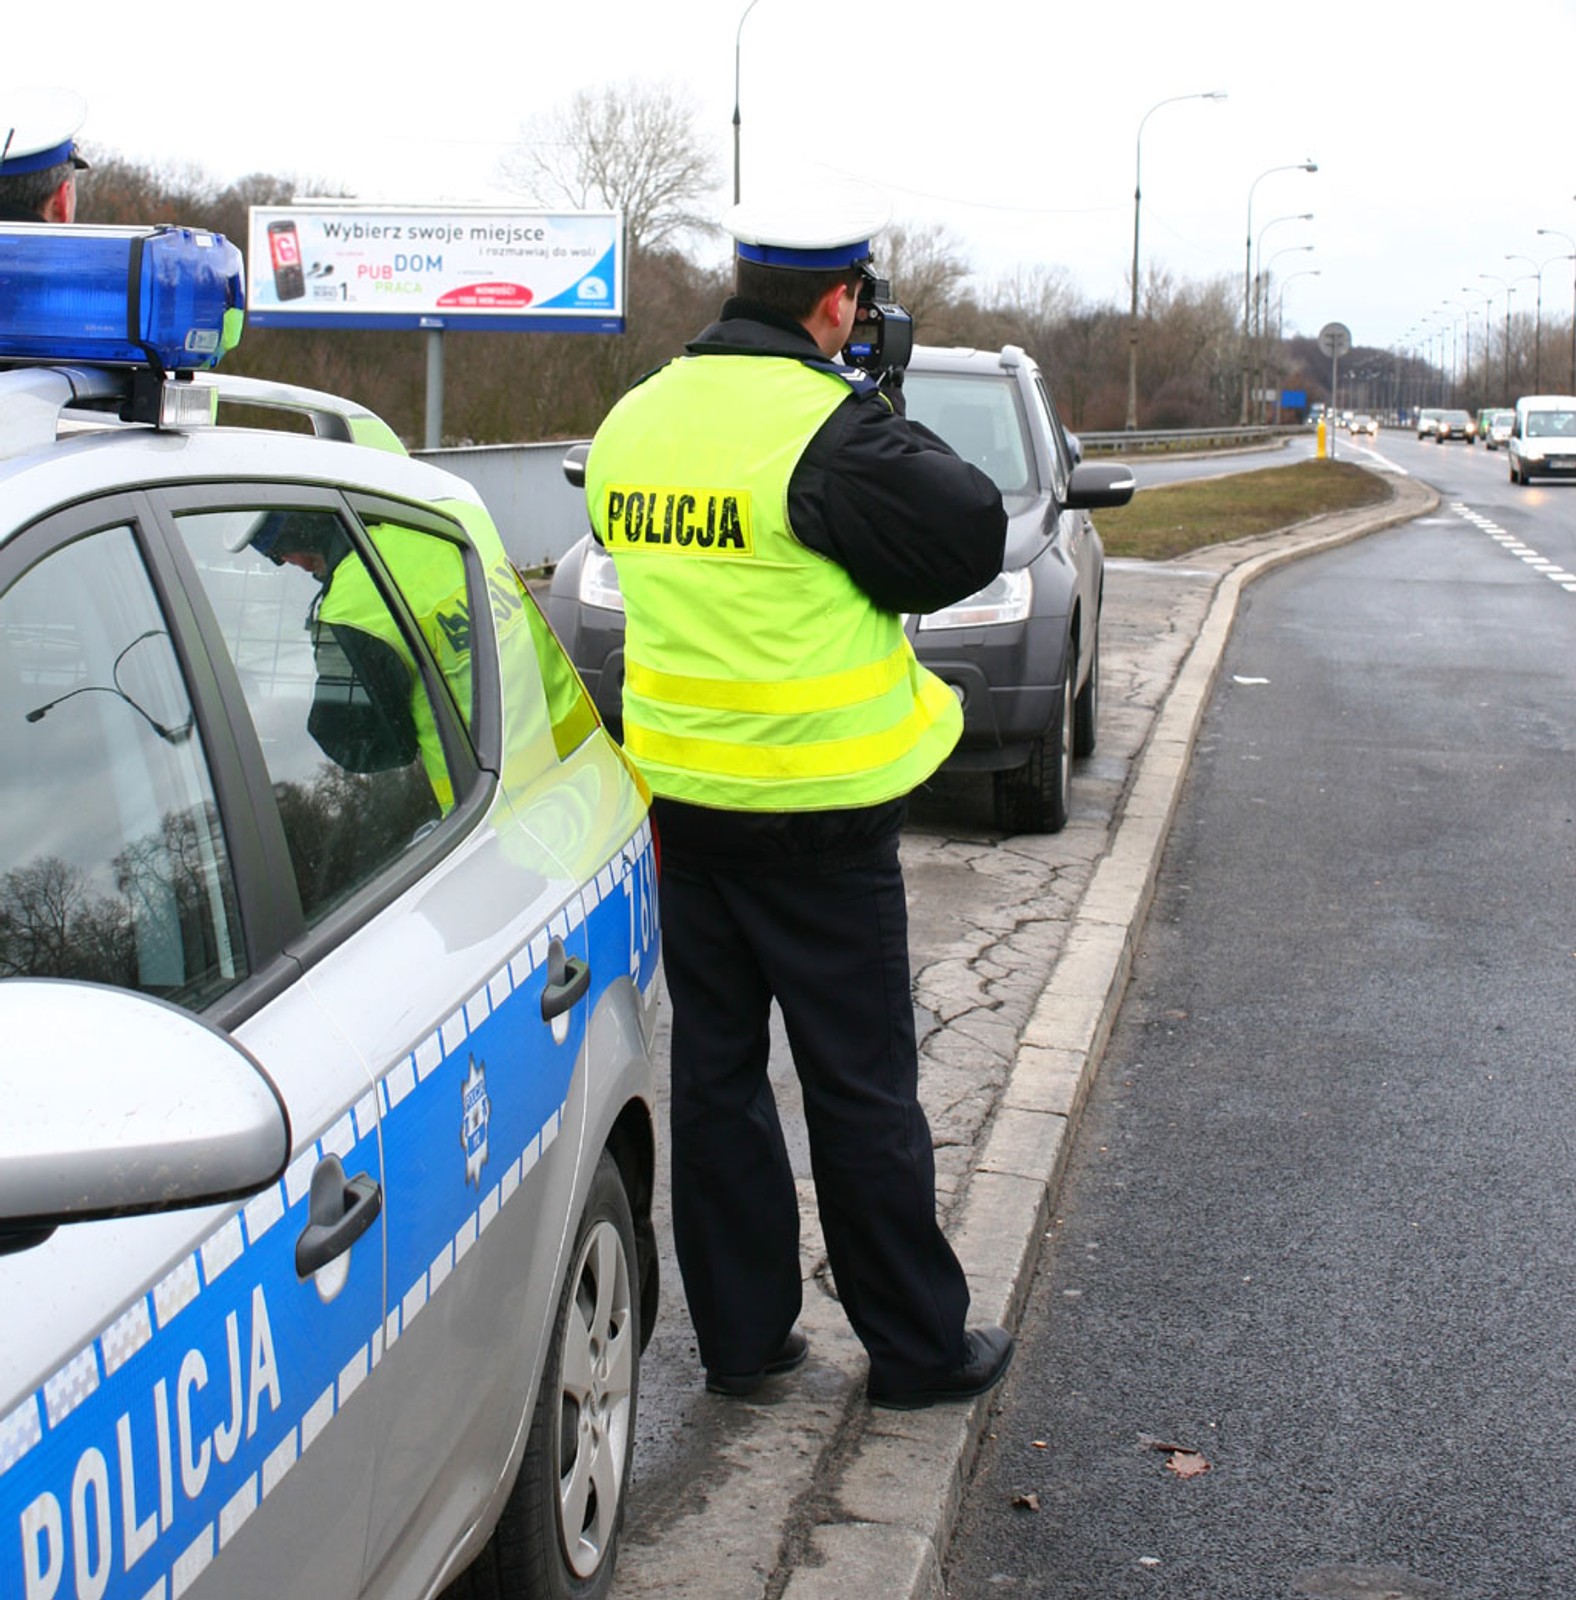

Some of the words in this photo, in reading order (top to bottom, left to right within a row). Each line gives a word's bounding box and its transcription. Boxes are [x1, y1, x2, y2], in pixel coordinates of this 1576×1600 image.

[322, 222, 402, 241] Wybierz
[407, 224, 464, 242] swoje
[470, 225, 545, 245] miejsce
[486, 247, 549, 259] rozmawiaj
[553, 247, 568, 257] do
[357, 264, 392, 280] PUB
[394, 254, 443, 273] DOM
[339, 282, 349, 302] 1
[375, 281, 423, 295] PRACA
[607, 490, 746, 549] POLICJA
[20, 1282, 282, 1600] POLICJA
